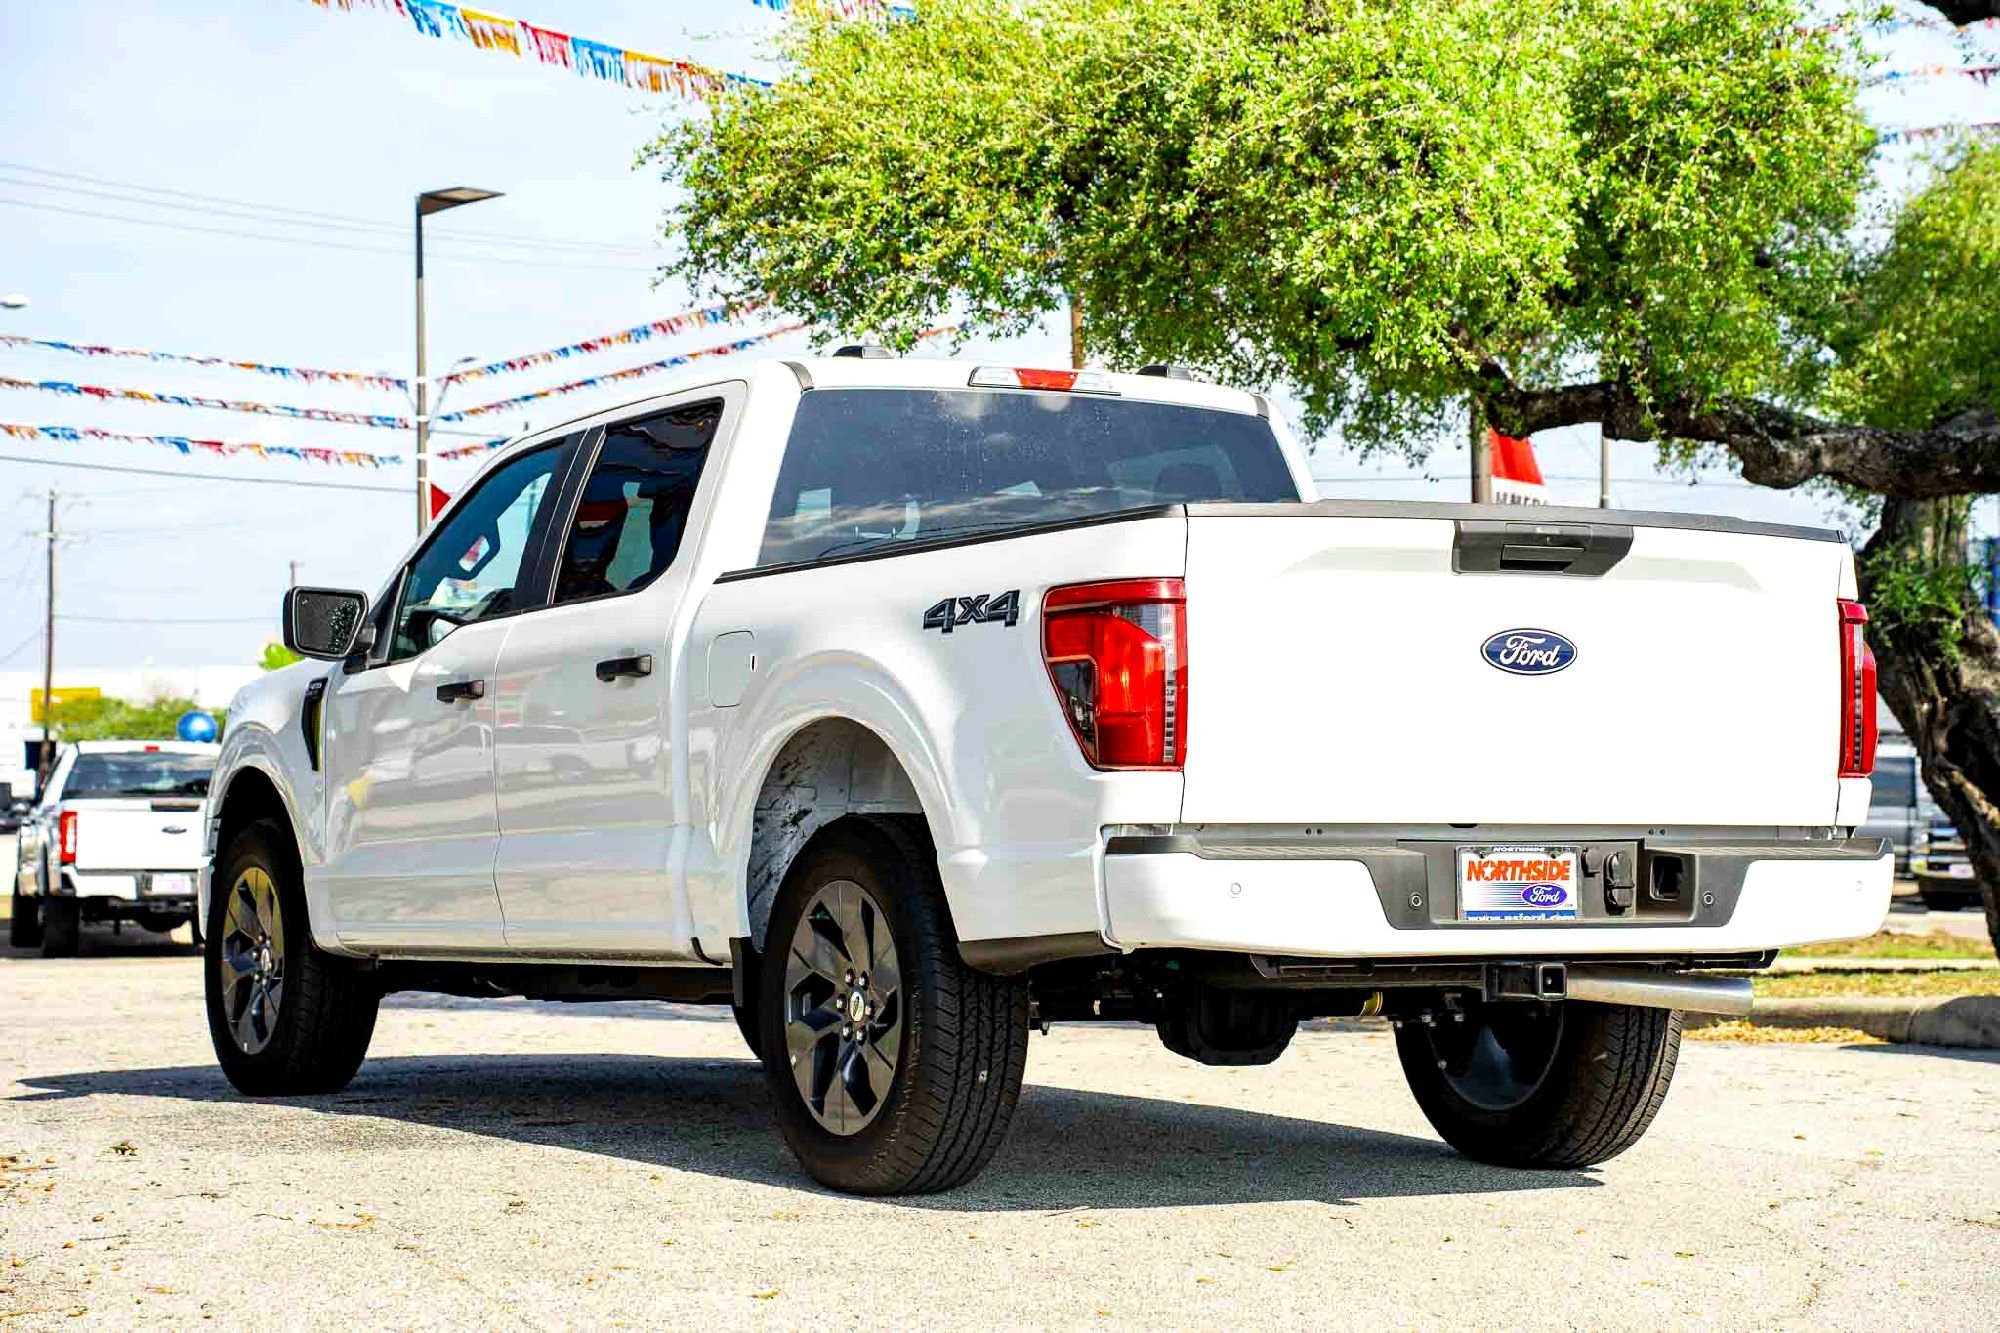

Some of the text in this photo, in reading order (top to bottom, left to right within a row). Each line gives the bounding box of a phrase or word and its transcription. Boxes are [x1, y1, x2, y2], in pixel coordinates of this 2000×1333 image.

[1499, 635, 1561, 666] Ford
[1467, 860, 1571, 881] NORTHSIDE
[1529, 885, 1560, 903] Ford
